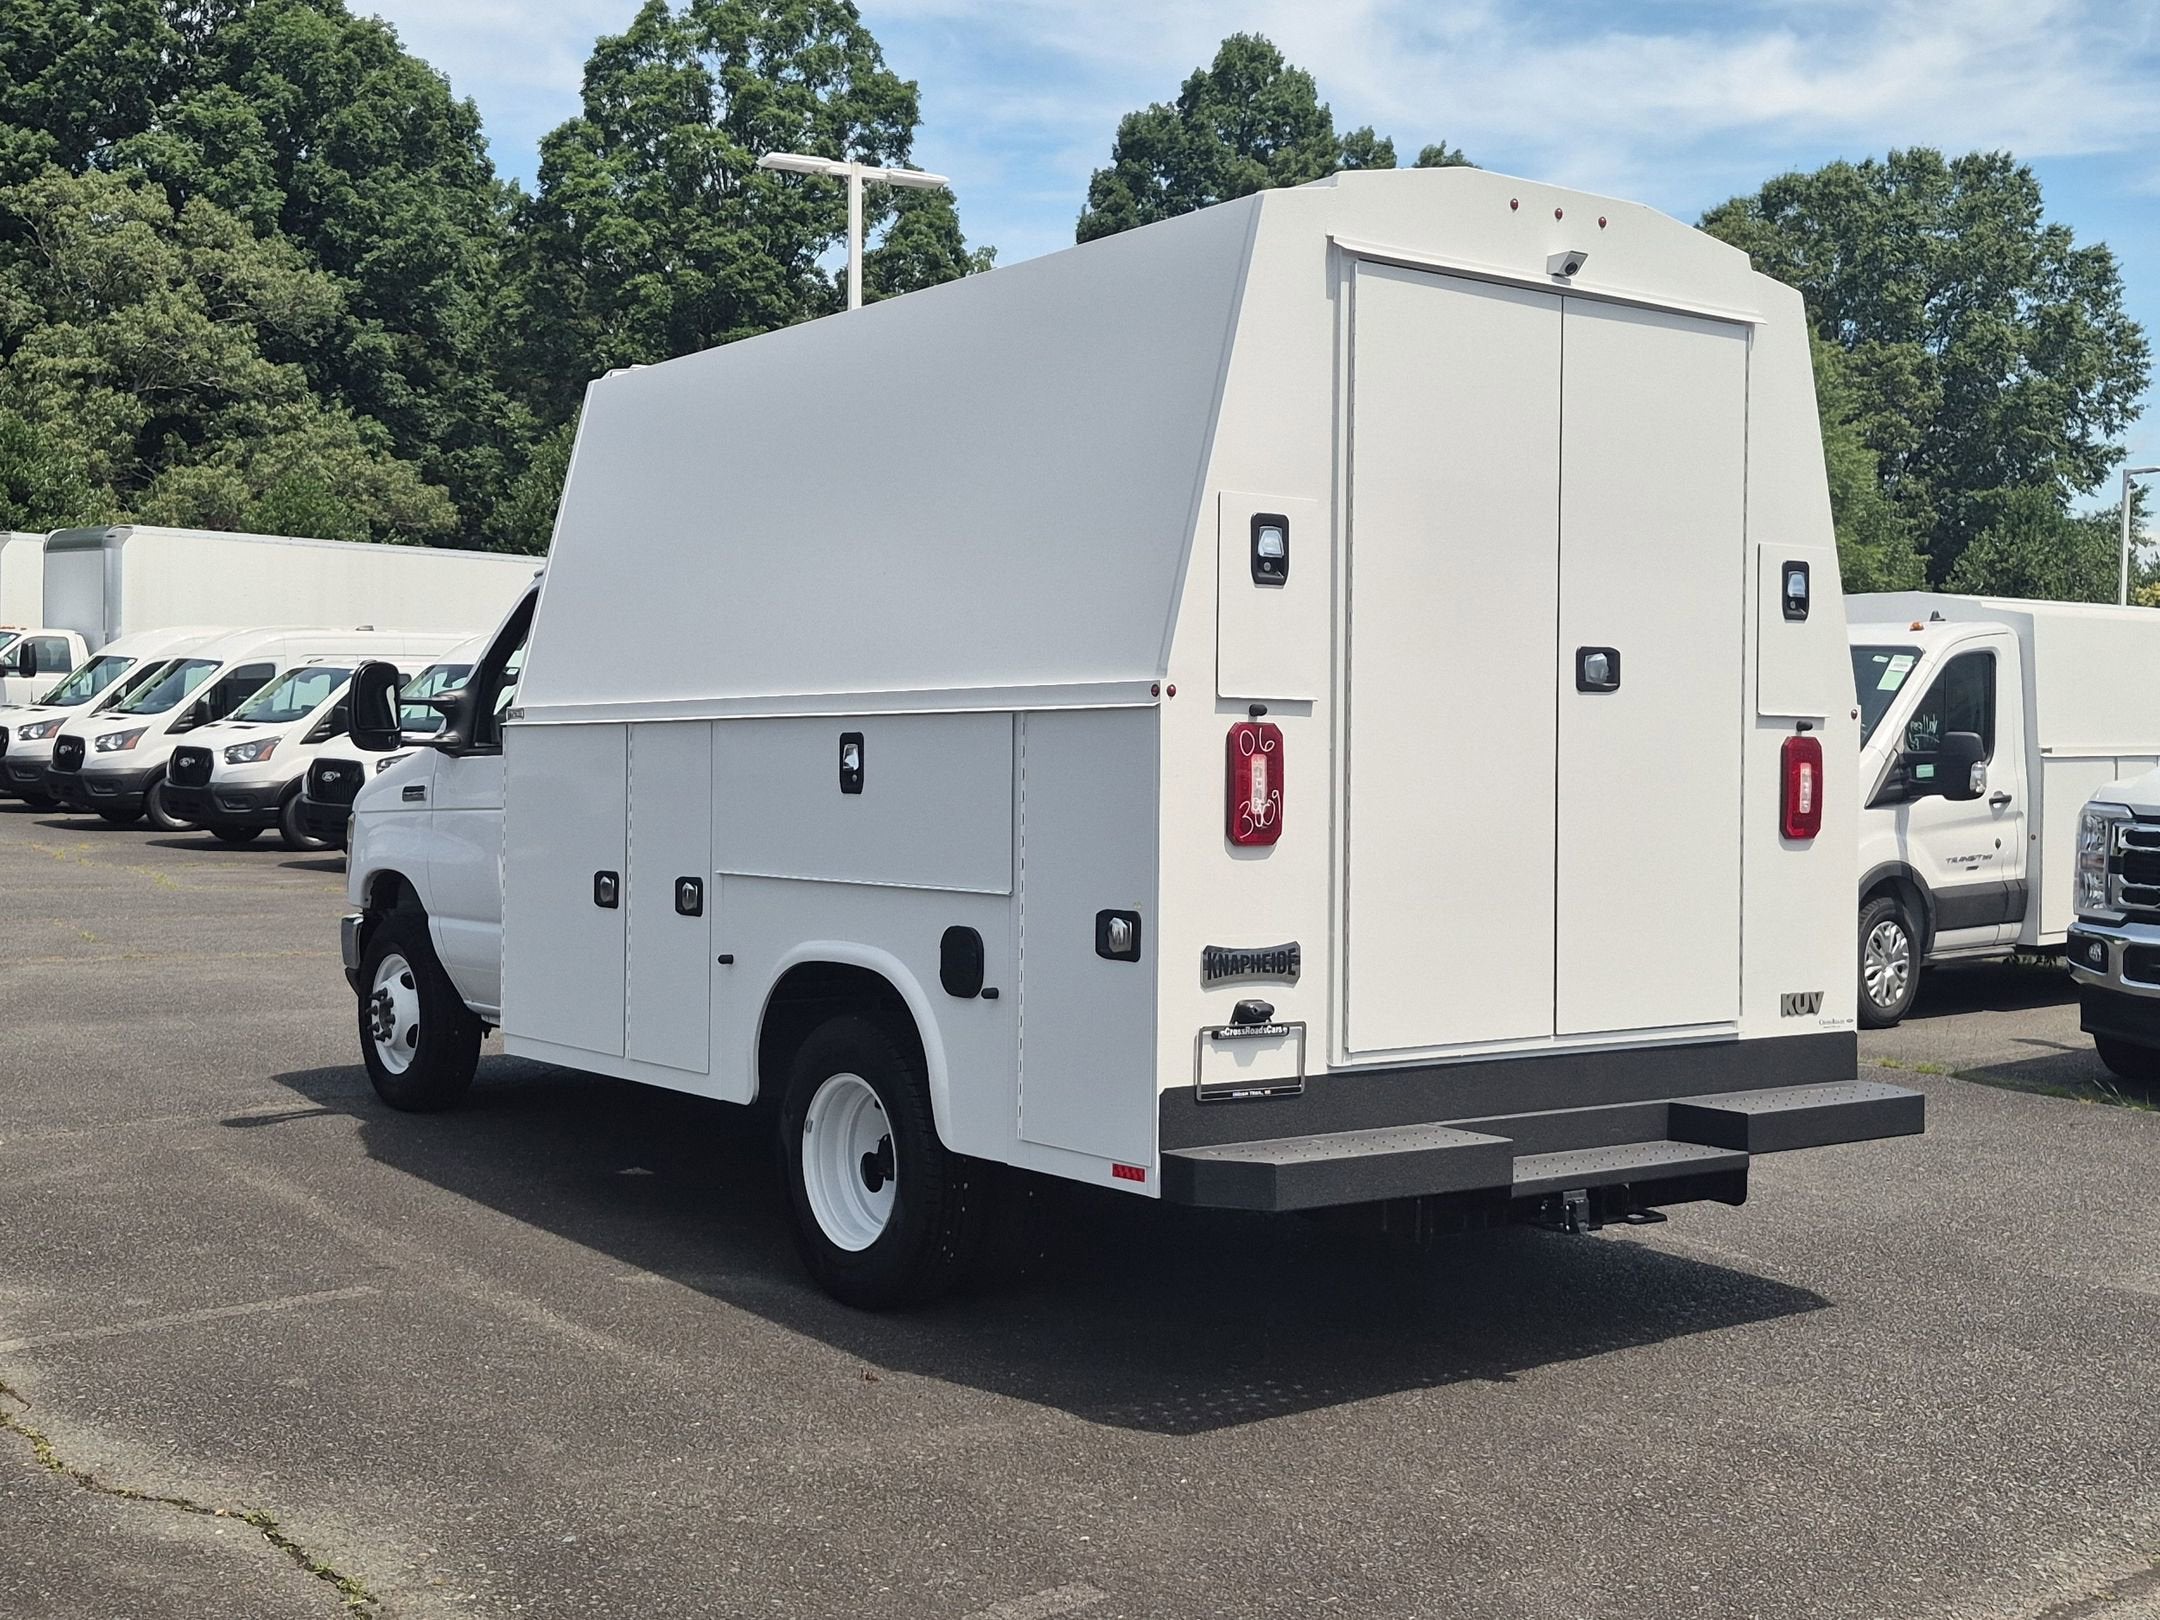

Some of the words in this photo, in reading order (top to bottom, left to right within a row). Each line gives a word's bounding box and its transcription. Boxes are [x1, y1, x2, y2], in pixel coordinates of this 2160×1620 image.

[1239, 727, 1275, 757] 06
[1206, 948, 1298, 980] KNAPHEIDE
[1780, 991, 1824, 1017] KUV
